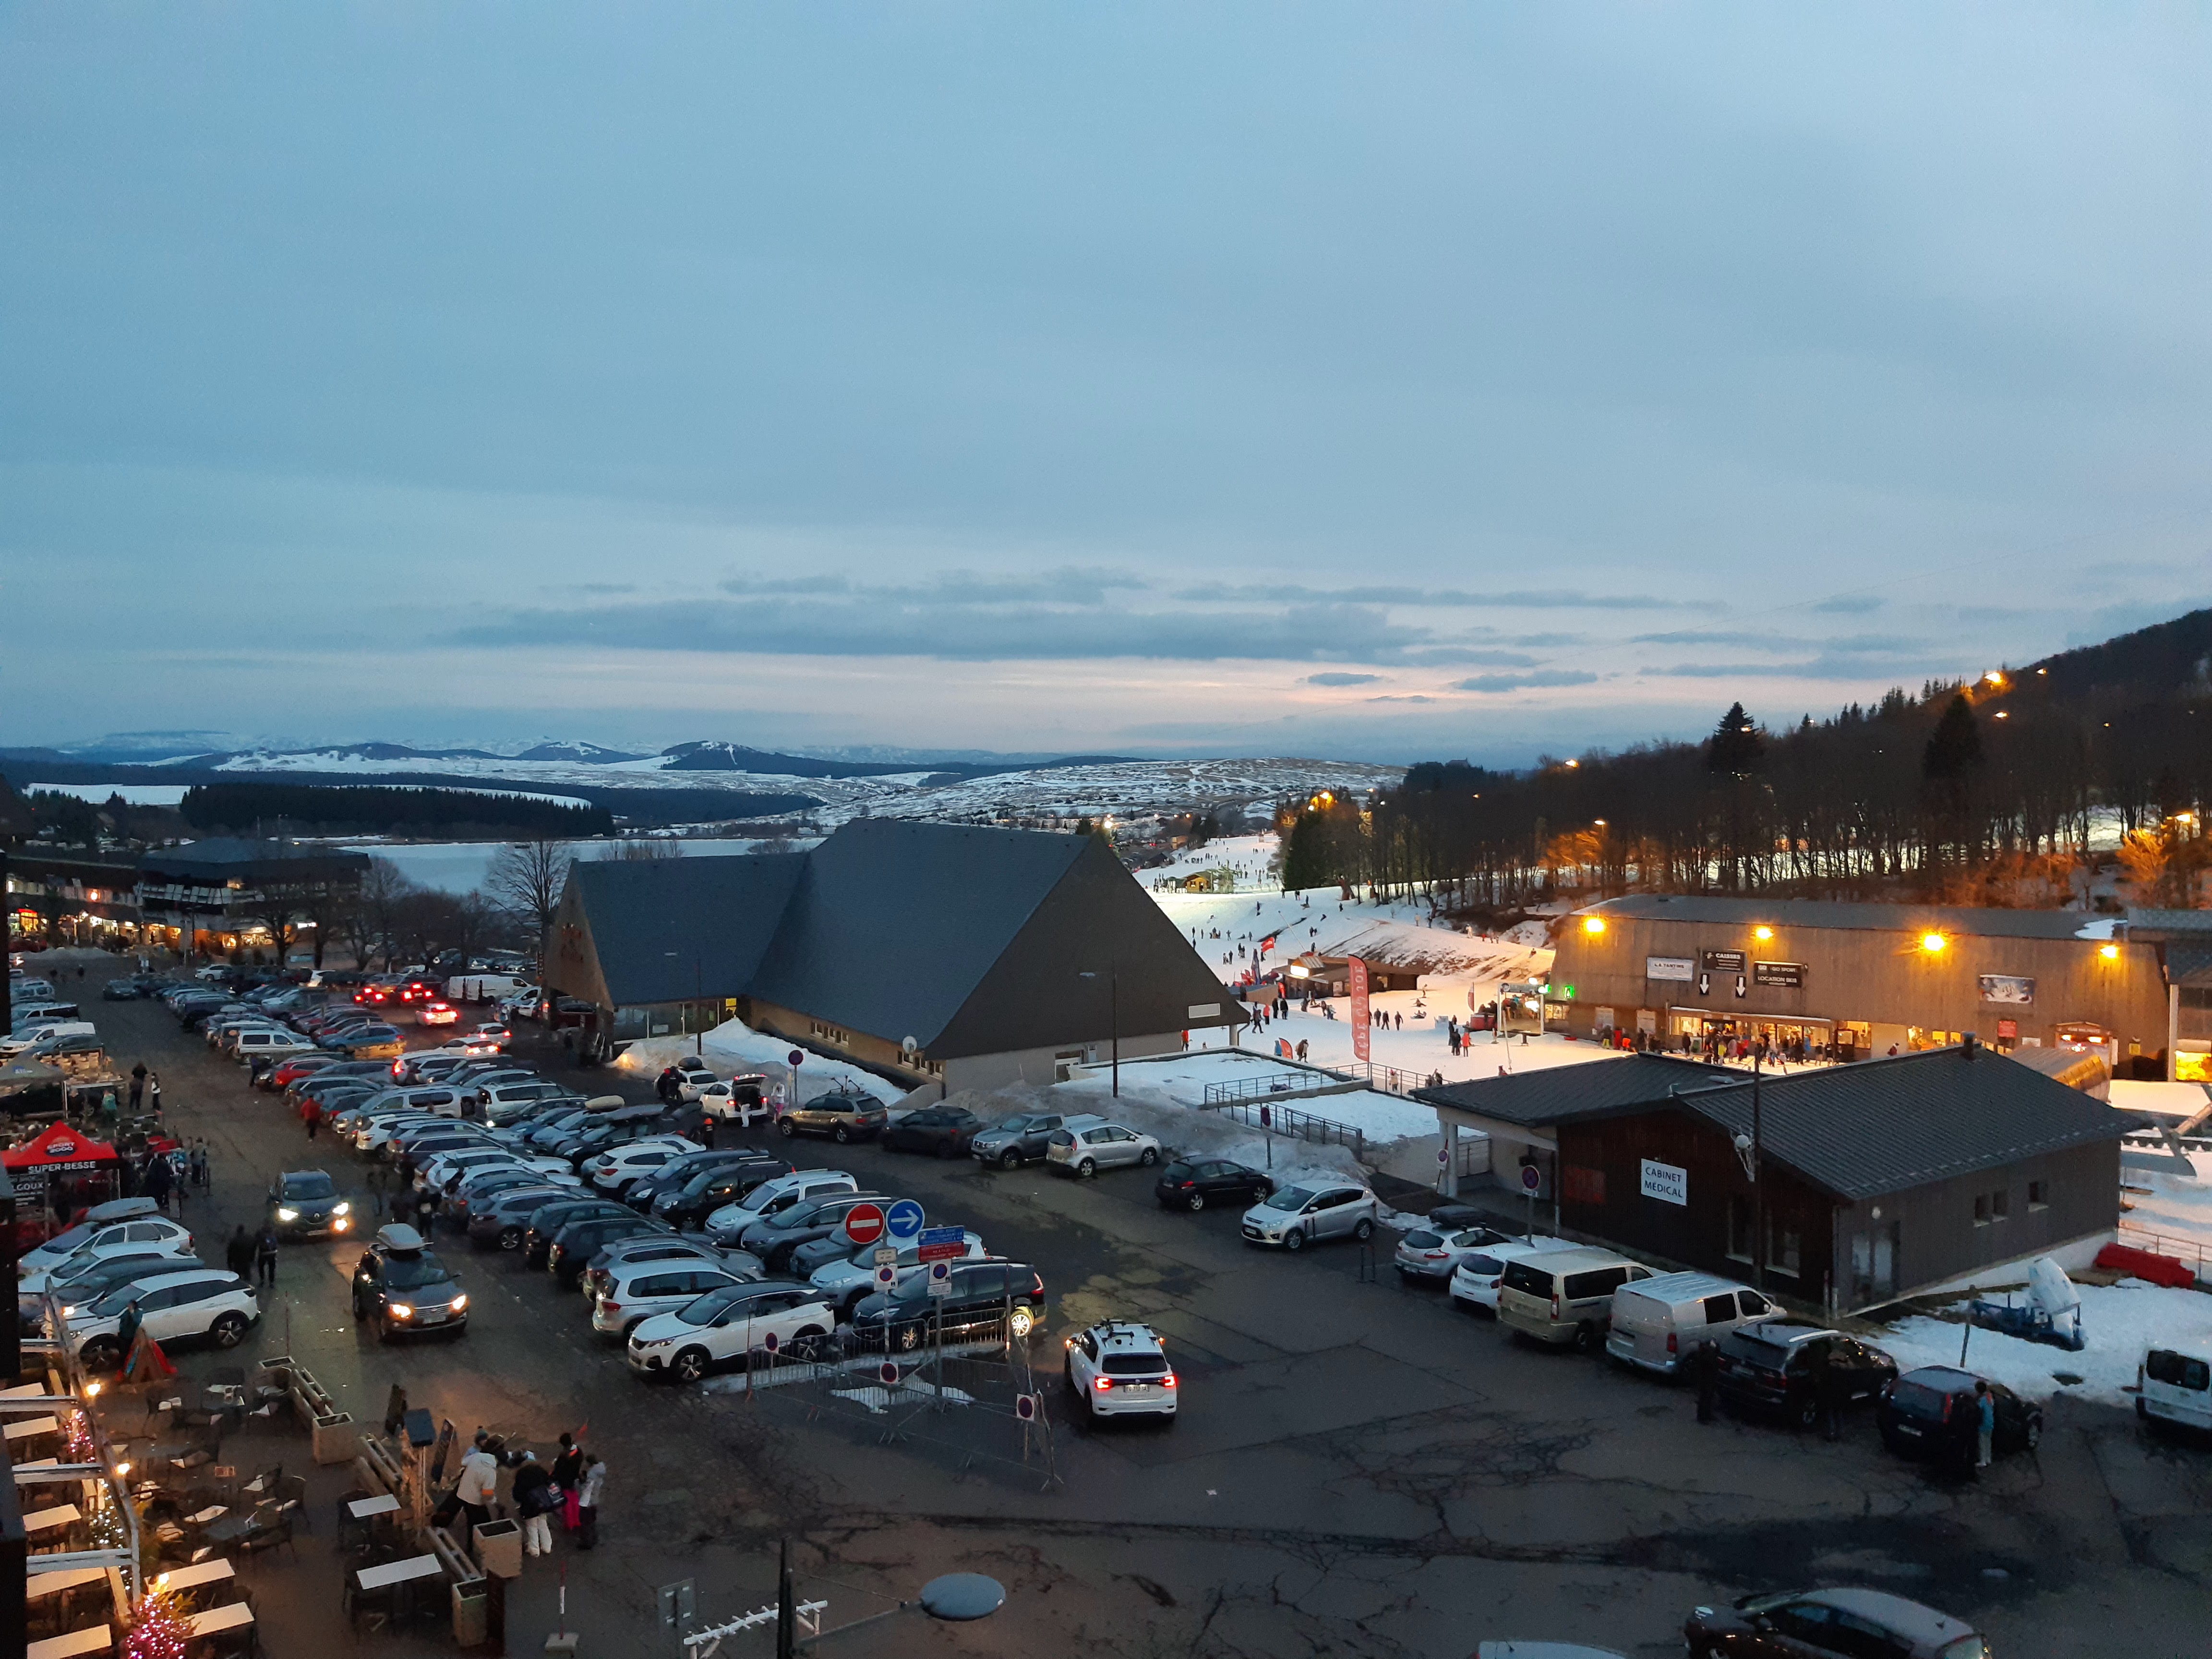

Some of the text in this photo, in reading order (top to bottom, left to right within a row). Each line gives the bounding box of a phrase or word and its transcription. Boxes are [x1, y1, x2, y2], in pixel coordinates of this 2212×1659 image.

[28, 1161, 96, 1174] SUPER-BESSE
[1646, 1167, 1682, 1183] CABINET
[1644, 1179, 1683, 1198] MEDICAL
